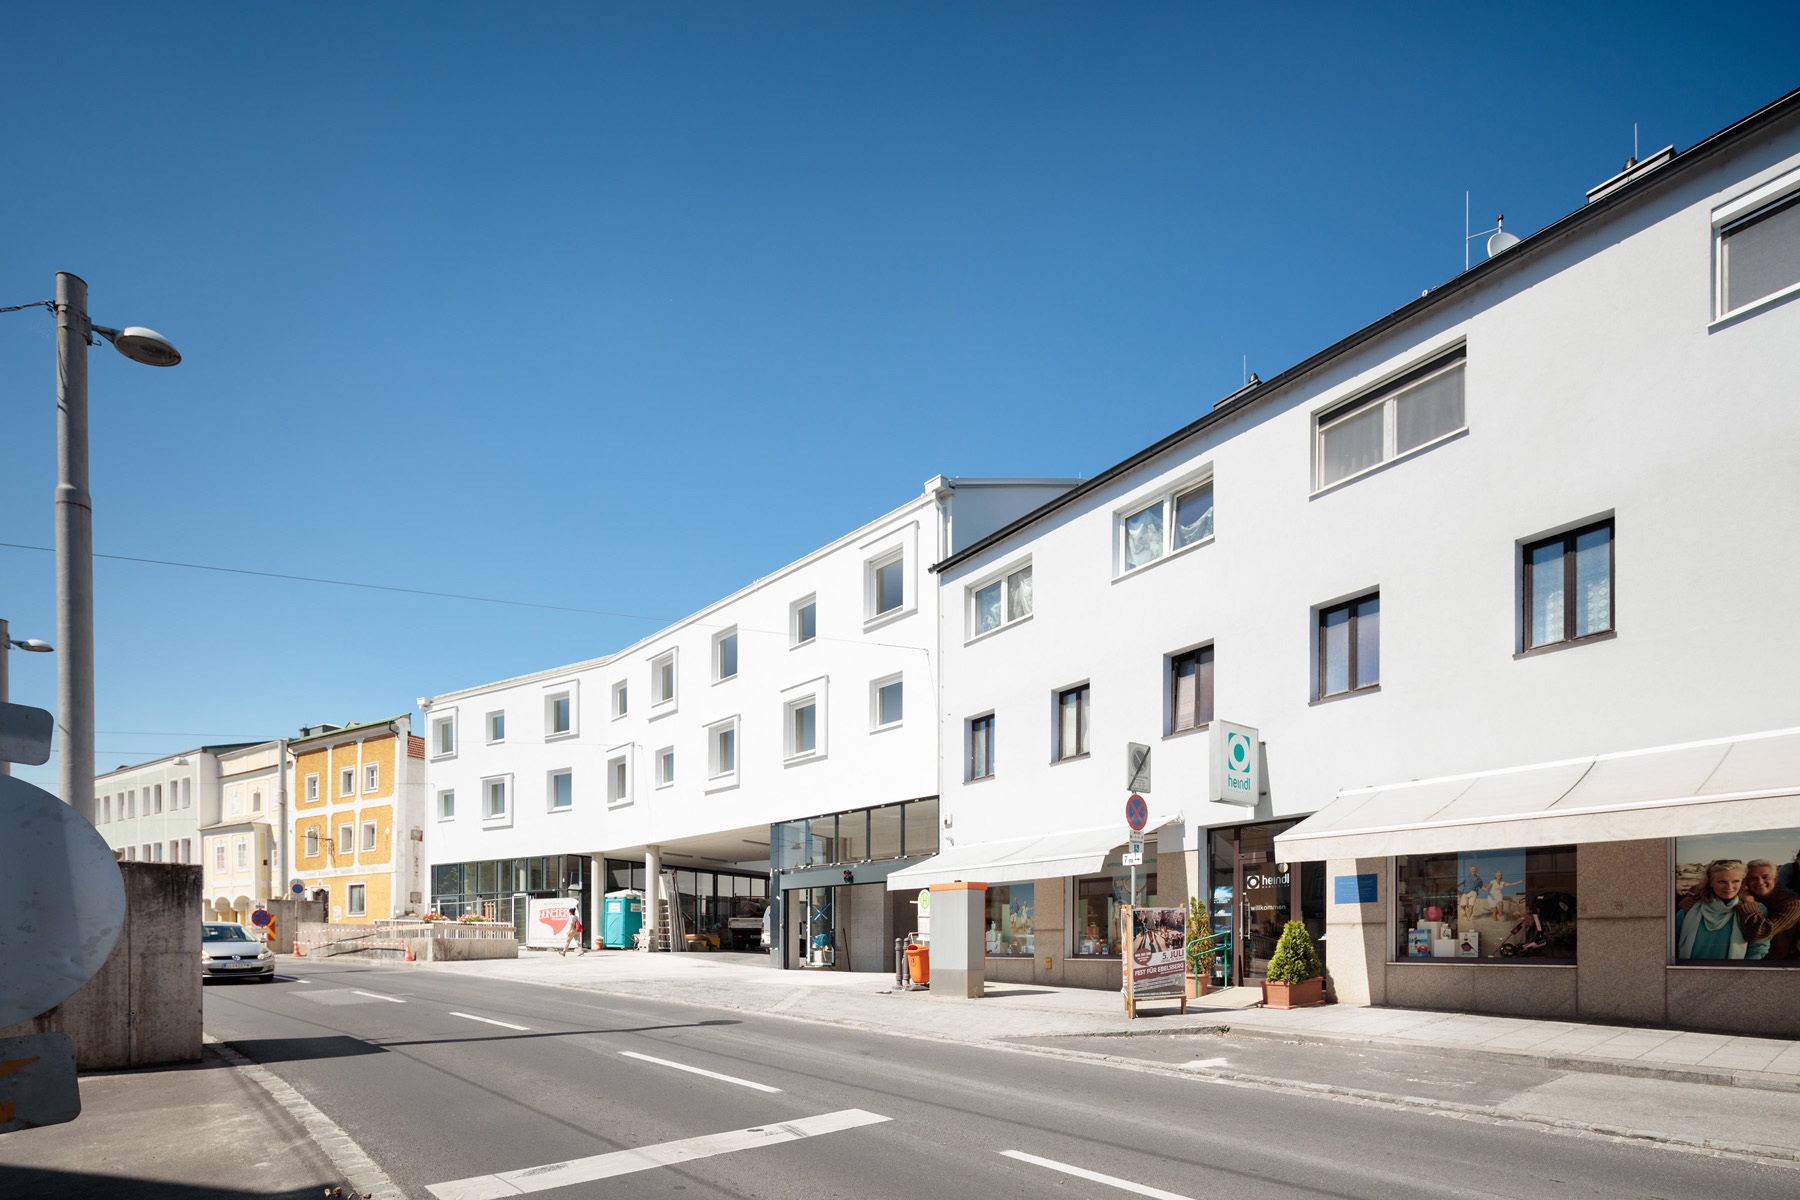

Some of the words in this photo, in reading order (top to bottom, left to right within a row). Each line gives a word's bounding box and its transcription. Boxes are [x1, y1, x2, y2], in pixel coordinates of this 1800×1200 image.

[1227, 773, 1251, 791] heindl
[1262, 872, 1290, 885] heindl
[1162, 952, 1169, 960] 5.
[1170, 949, 1185, 958] JULI
[1147, 966, 1157, 974] FÜR
